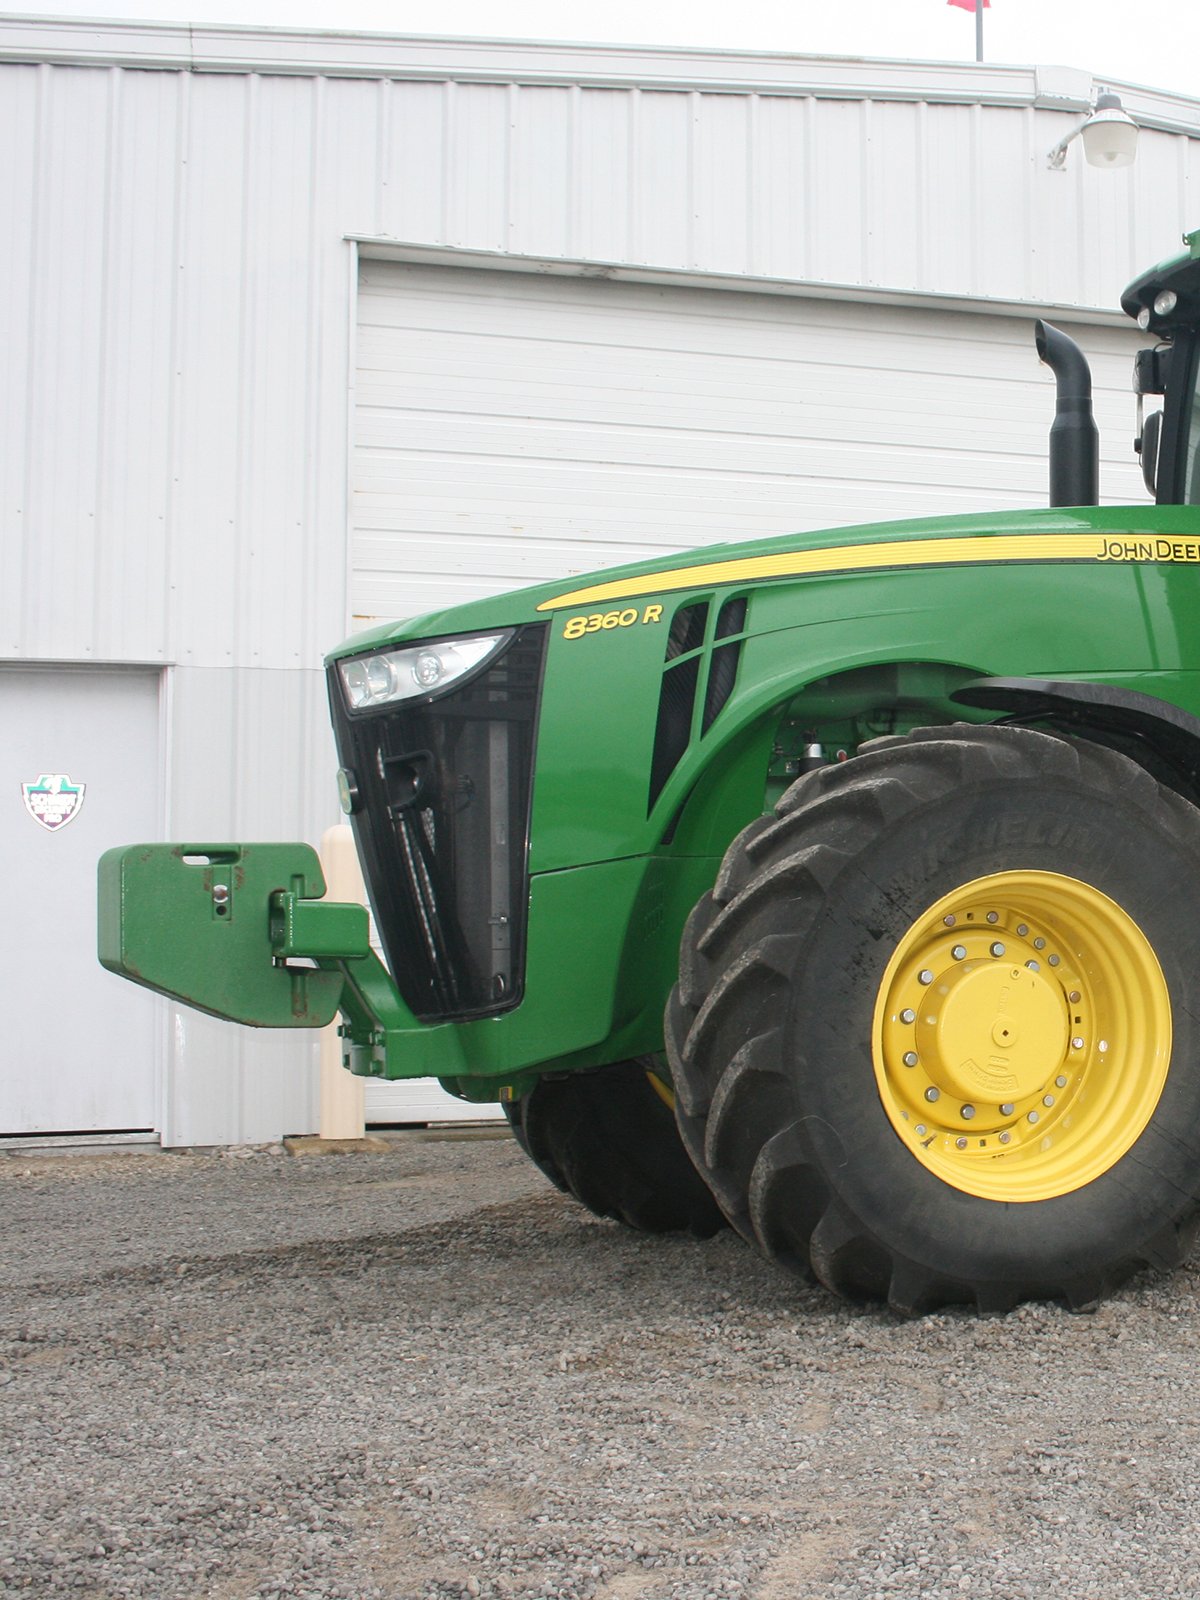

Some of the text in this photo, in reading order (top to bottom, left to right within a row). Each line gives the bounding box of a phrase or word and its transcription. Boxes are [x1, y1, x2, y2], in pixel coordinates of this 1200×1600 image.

[1096, 538, 1153, 559] JOHN
[563, 604, 664, 640] 8360 R
